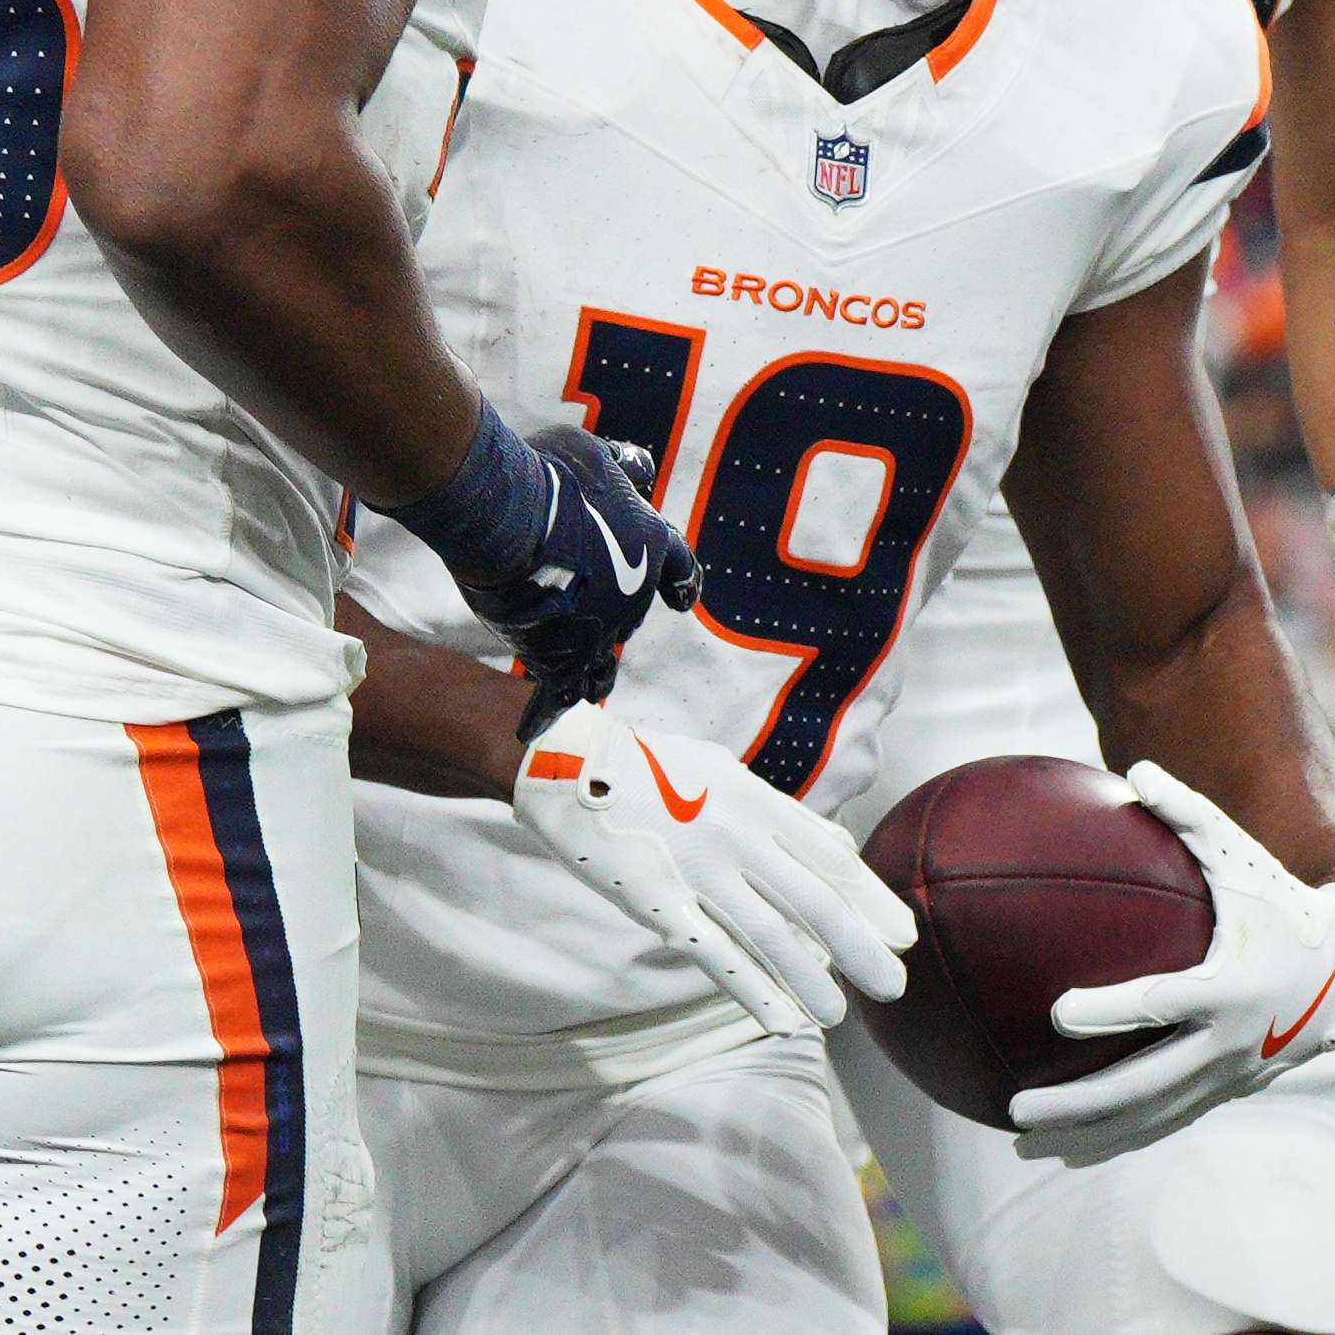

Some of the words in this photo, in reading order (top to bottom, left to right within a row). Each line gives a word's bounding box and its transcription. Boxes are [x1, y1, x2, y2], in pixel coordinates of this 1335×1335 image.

[817, 161, 861, 197] NFL
[691, 265, 928, 330] BRONCOS
[561, 306, 974, 800] 19
